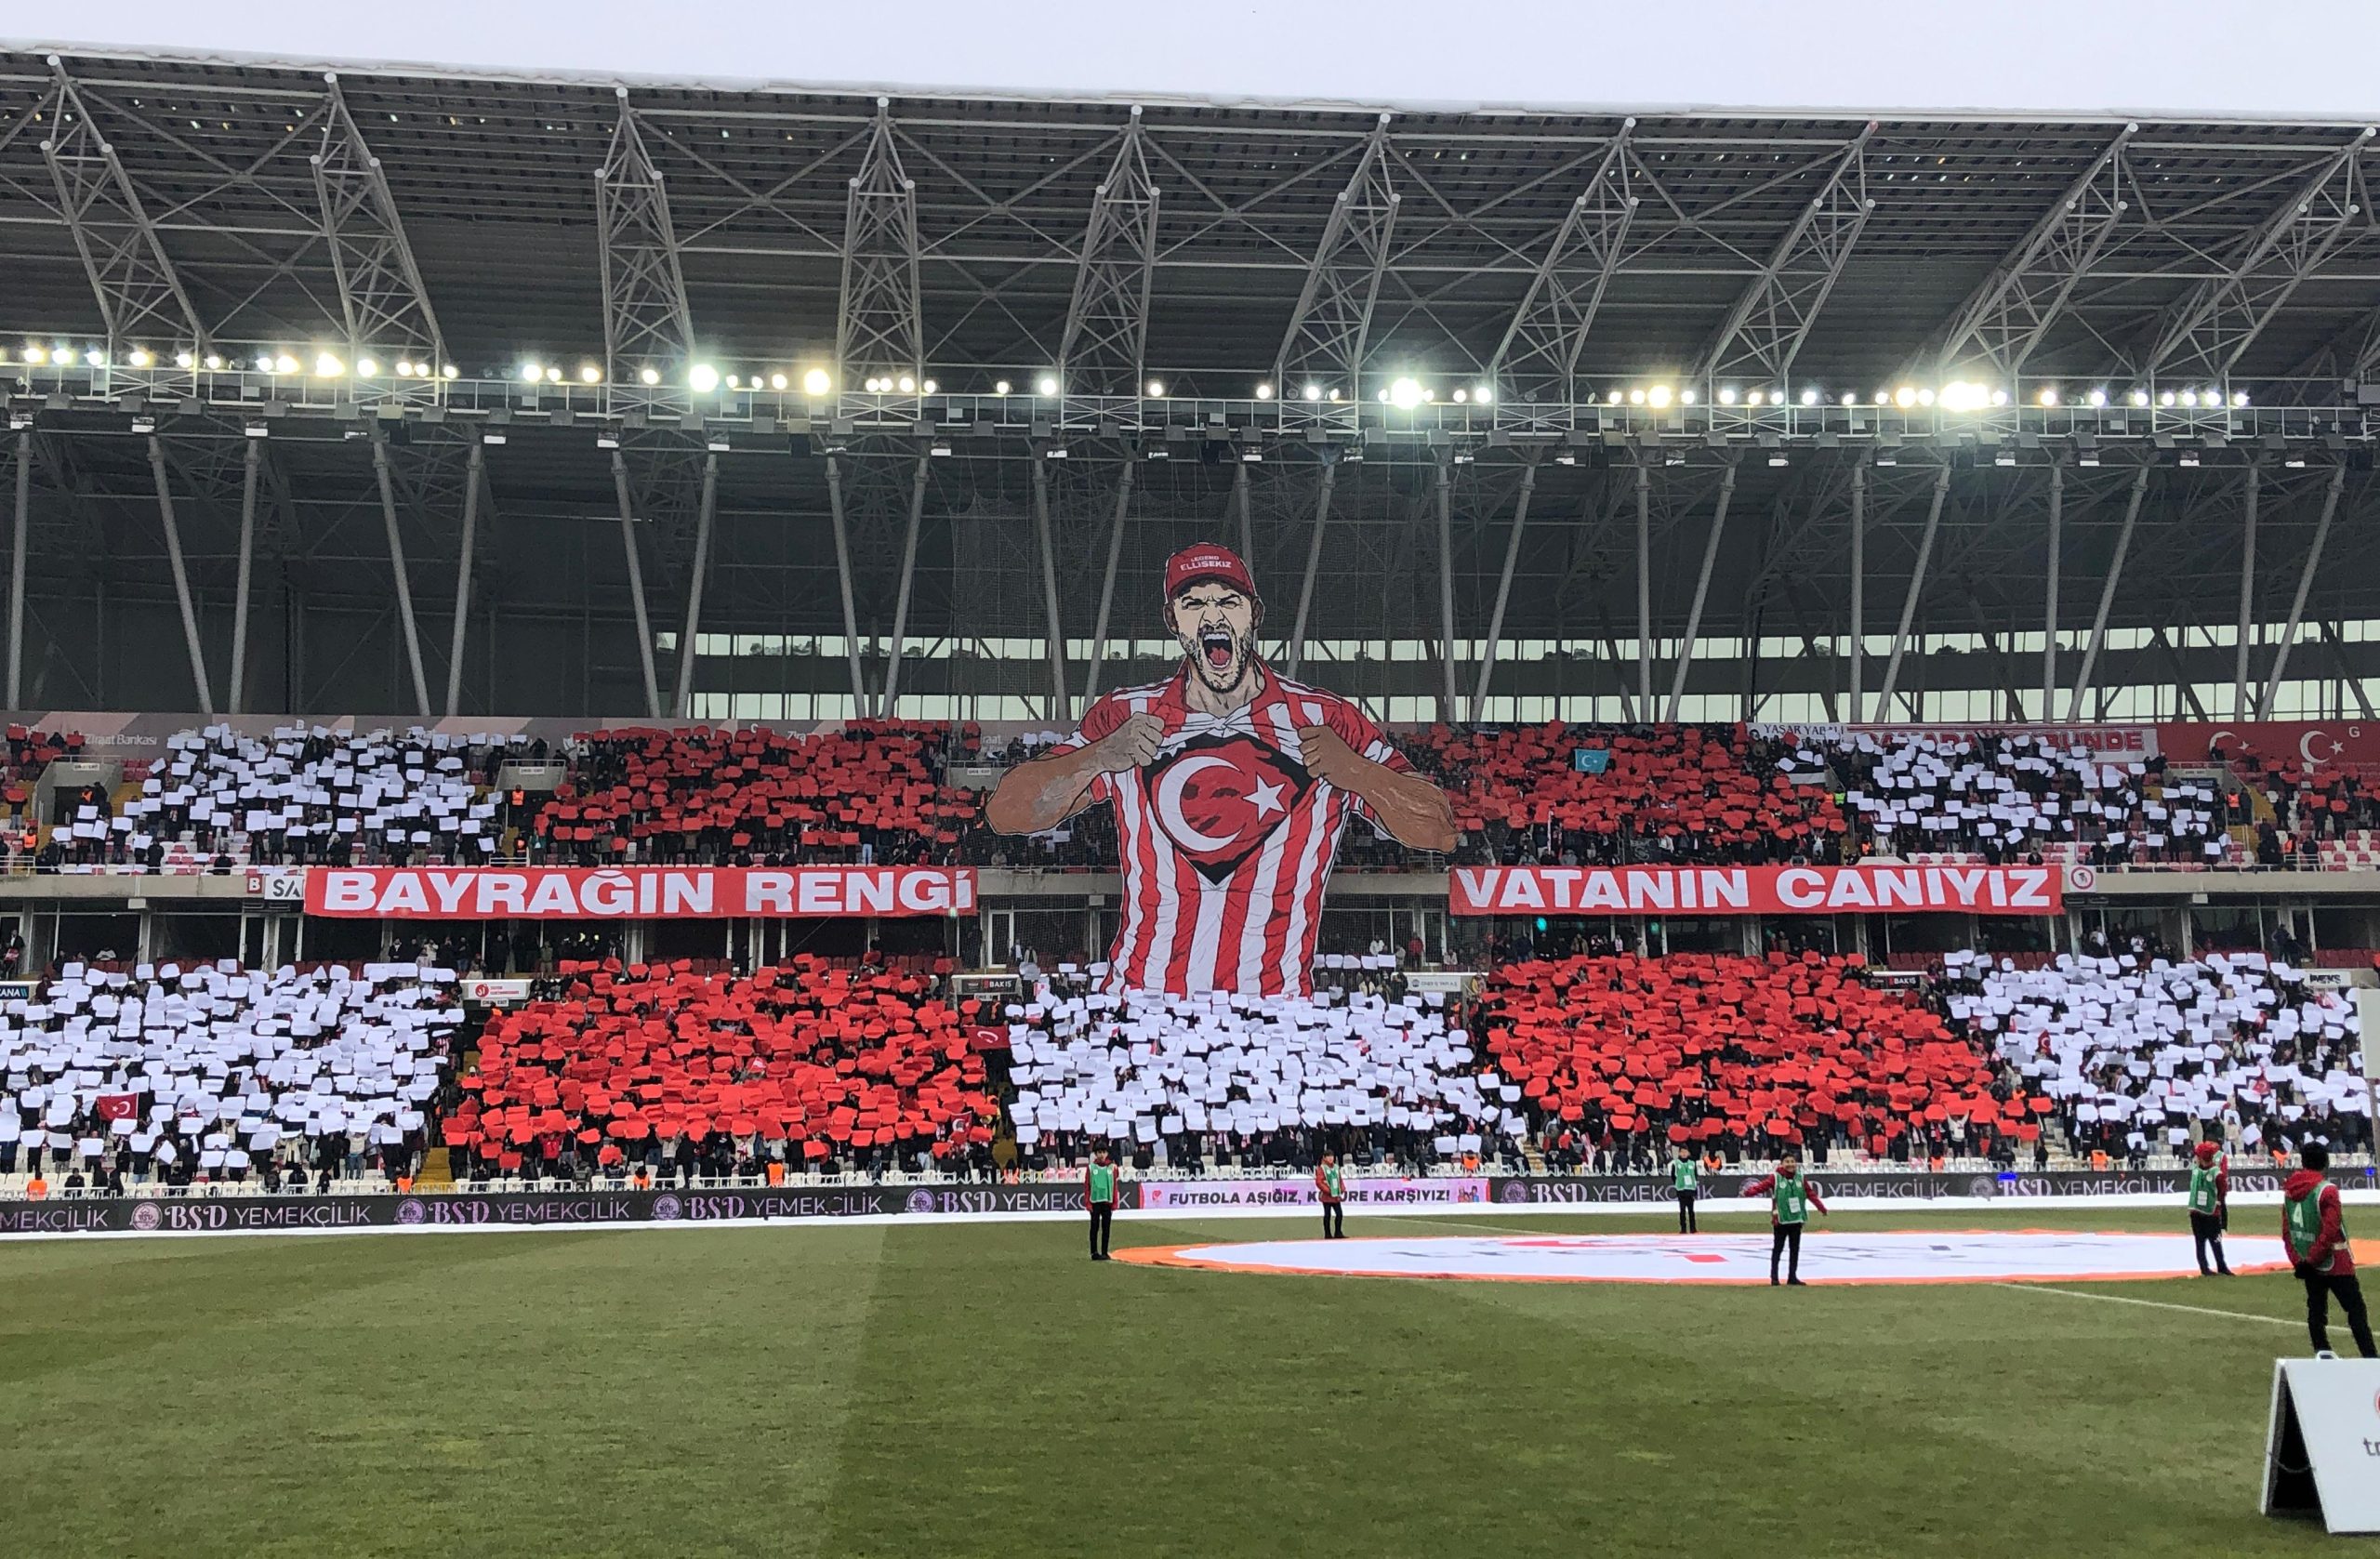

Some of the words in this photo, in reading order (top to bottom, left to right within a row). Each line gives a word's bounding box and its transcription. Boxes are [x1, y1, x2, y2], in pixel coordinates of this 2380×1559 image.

[2348, 726, 2360, 737] G
[248, 877, 260, 892] B
[272, 879, 300, 897] SA
[324, 870, 713, 915] BAYRAĞIN
[1456, 868, 1750, 908] VATANIN
[1776, 868, 2050, 907] CANIYIZ
[0, 988, 20, 997] ANA
[937, 1191, 997, 1212] BSD
[1169, 1192, 1241, 1205] FUTBOLA
[1307, 1191, 1368, 1203] KRE
[1374, 1188, 1450, 1203] KARŞIYIZ!
[1531, 1183, 1588, 1202] BSD
[165, 1205, 228, 1230] BSD
[234, 1202, 372, 1228] YEMEKÇİLİK
[429, 1199, 489, 1224] BSD
[496, 1197, 630, 1222] YEMEKÇİLİK
[684, 1196, 745, 1219] BSD
